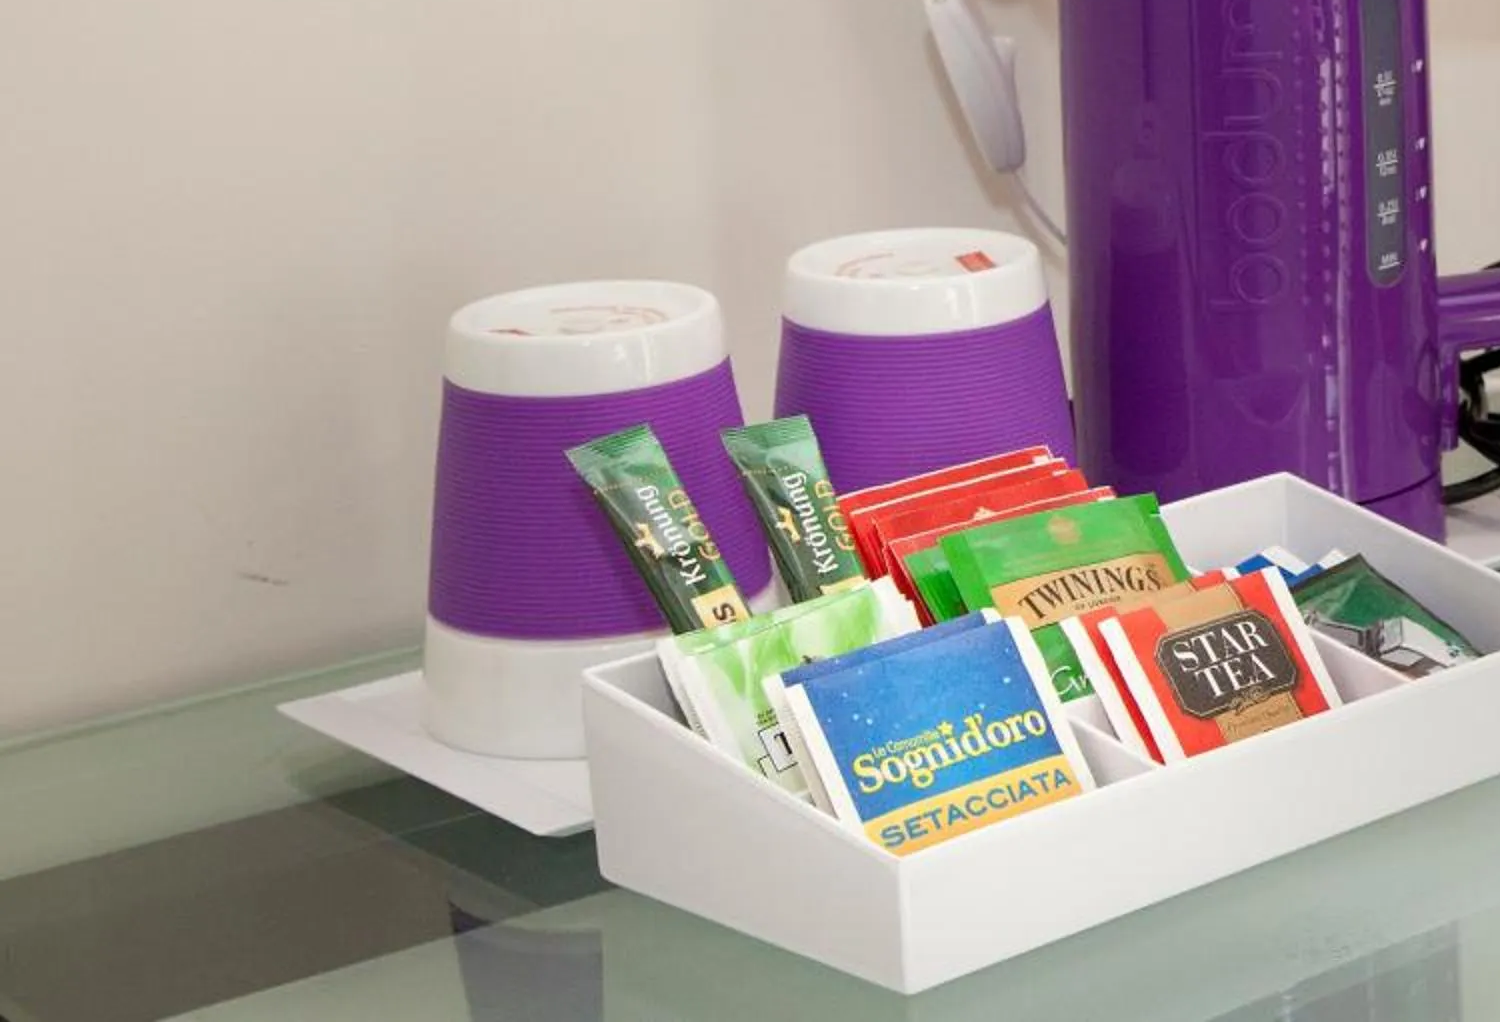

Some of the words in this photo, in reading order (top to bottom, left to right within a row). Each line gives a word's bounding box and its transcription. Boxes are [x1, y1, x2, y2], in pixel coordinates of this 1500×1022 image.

[634, 485, 706, 586] Krönung
[784, 470, 839, 575] Krönung
[1017, 564, 1164, 620] TWININGS
[1172, 620, 1270, 674] STAR
[1193, 655, 1277, 700] TEA
[879, 768, 1073, 849] SETACCIATA
